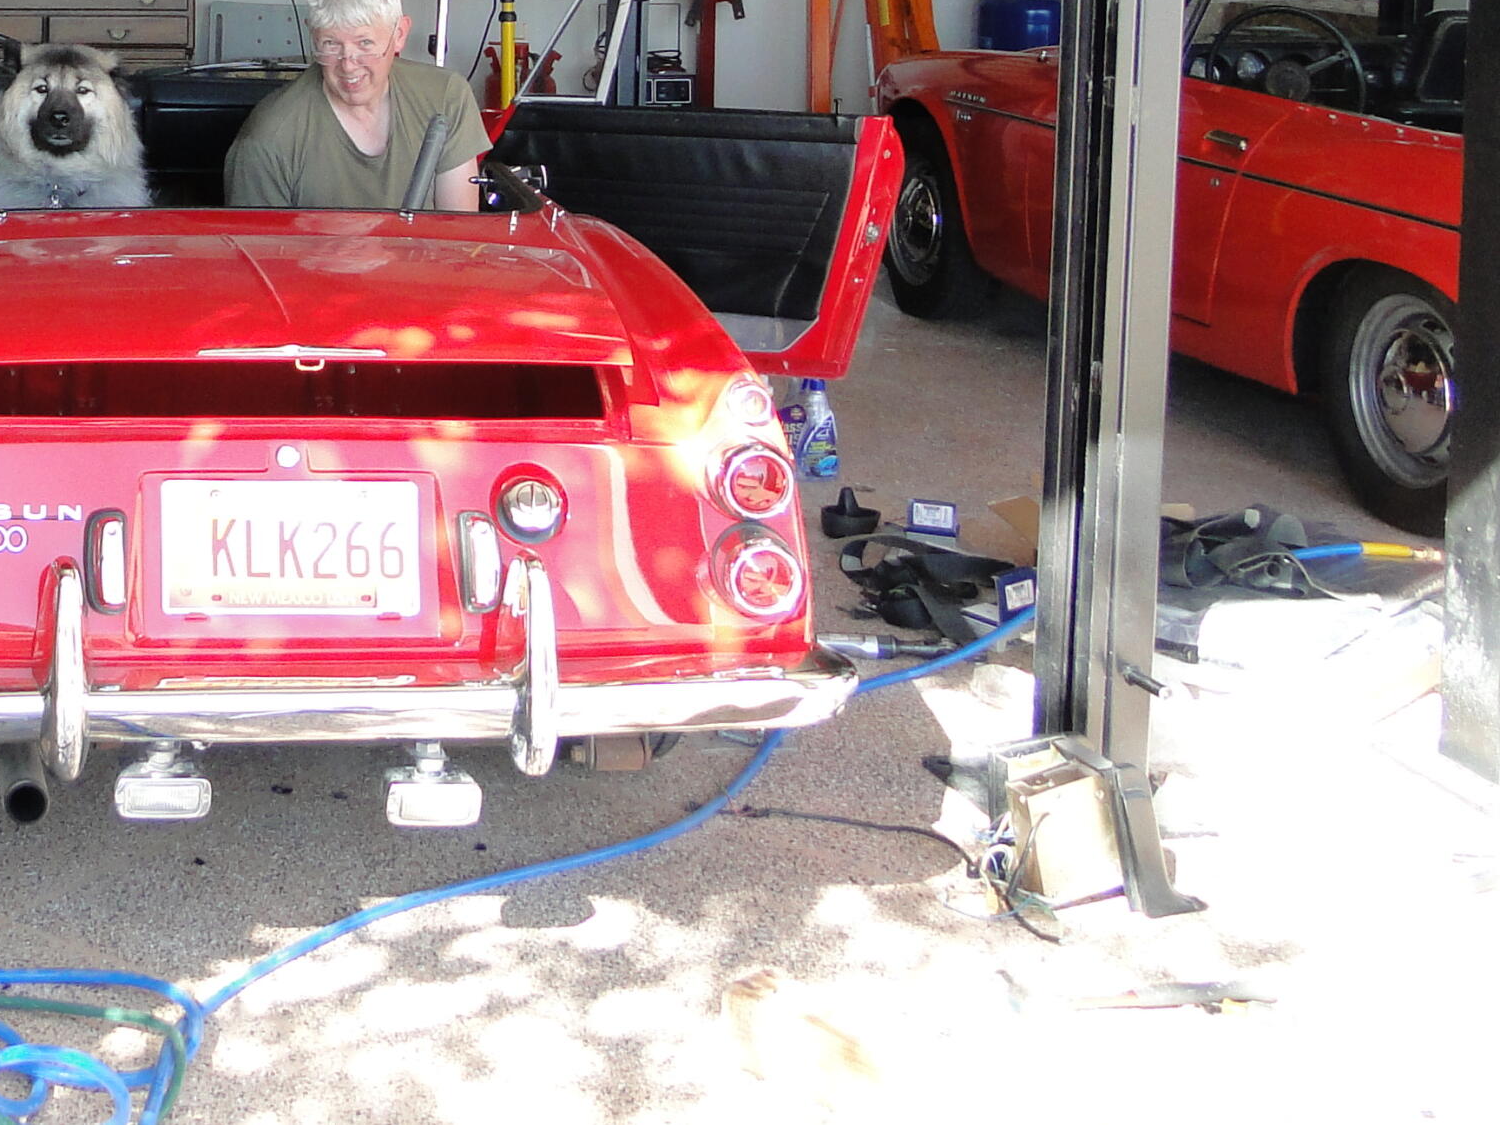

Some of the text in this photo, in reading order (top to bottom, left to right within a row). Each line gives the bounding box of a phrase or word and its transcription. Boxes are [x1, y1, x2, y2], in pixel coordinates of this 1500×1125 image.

[211, 518, 405, 579] KLK266
[229, 593, 261, 605] NEW
[266, 592, 323, 605] MEXICO
